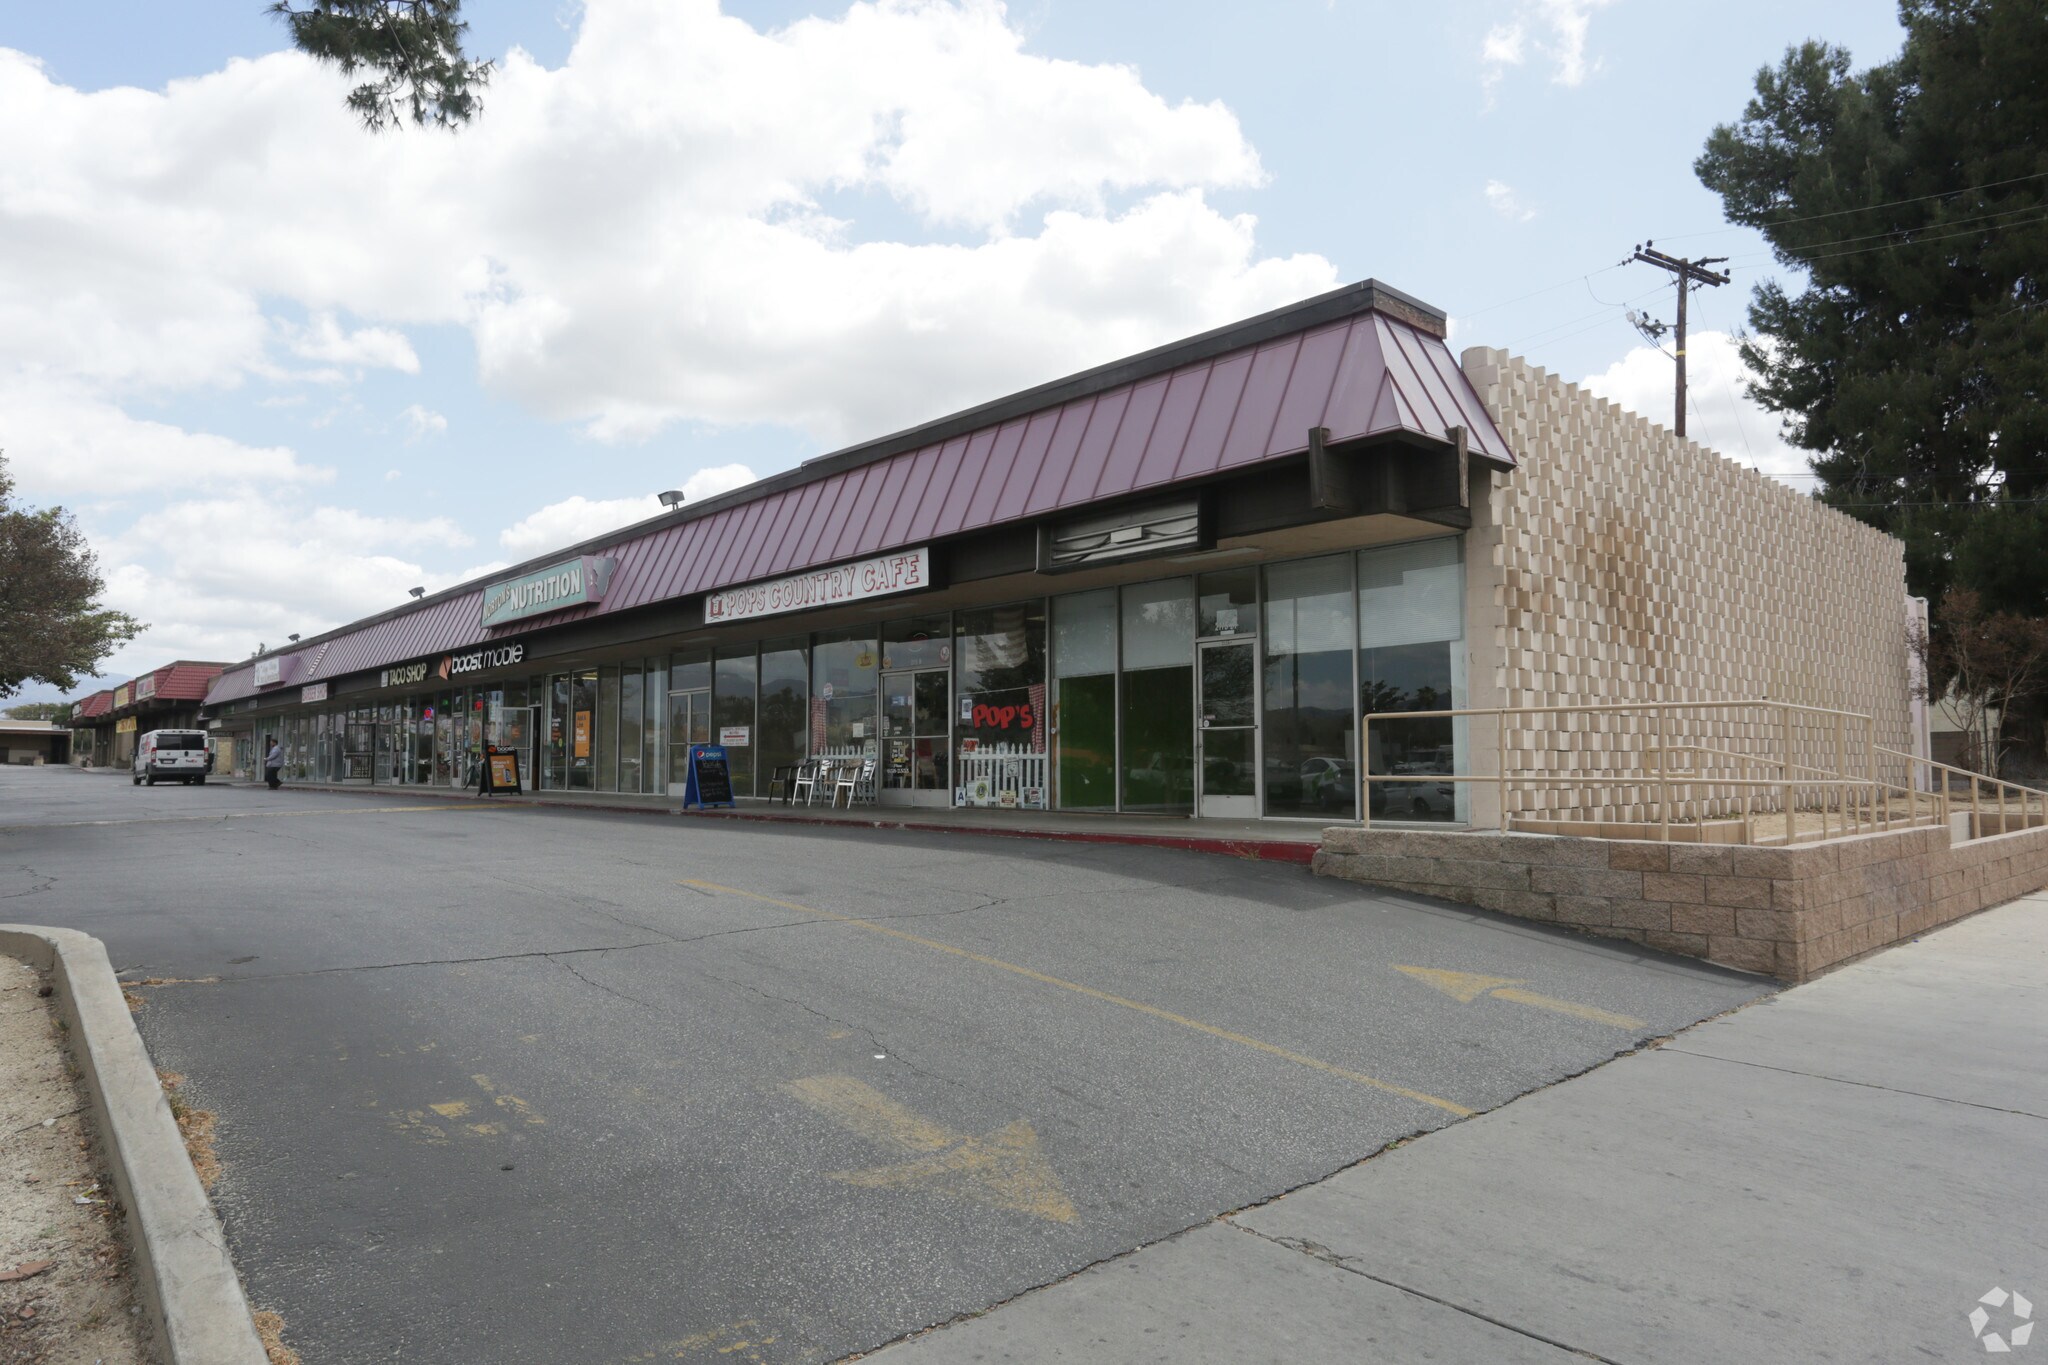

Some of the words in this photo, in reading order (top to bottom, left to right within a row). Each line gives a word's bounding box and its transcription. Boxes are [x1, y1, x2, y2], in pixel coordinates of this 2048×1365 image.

[483, 584, 511, 621] NORTON'S
[511, 568, 582, 612] NUTRITION
[726, 588, 766, 617] POPS
[770, 565, 856, 610] COUNTRY
[861, 553, 920, 592] CAFE
[452, 652, 483, 674] boost
[483, 643, 524, 669] mobile
[388, 668, 406, 686] TACO
[406, 662, 428, 683] SHOP
[972, 703, 1034, 729] POP'S
[705, 751, 722, 759] pepsi
[958, 791, 965, 801] A
